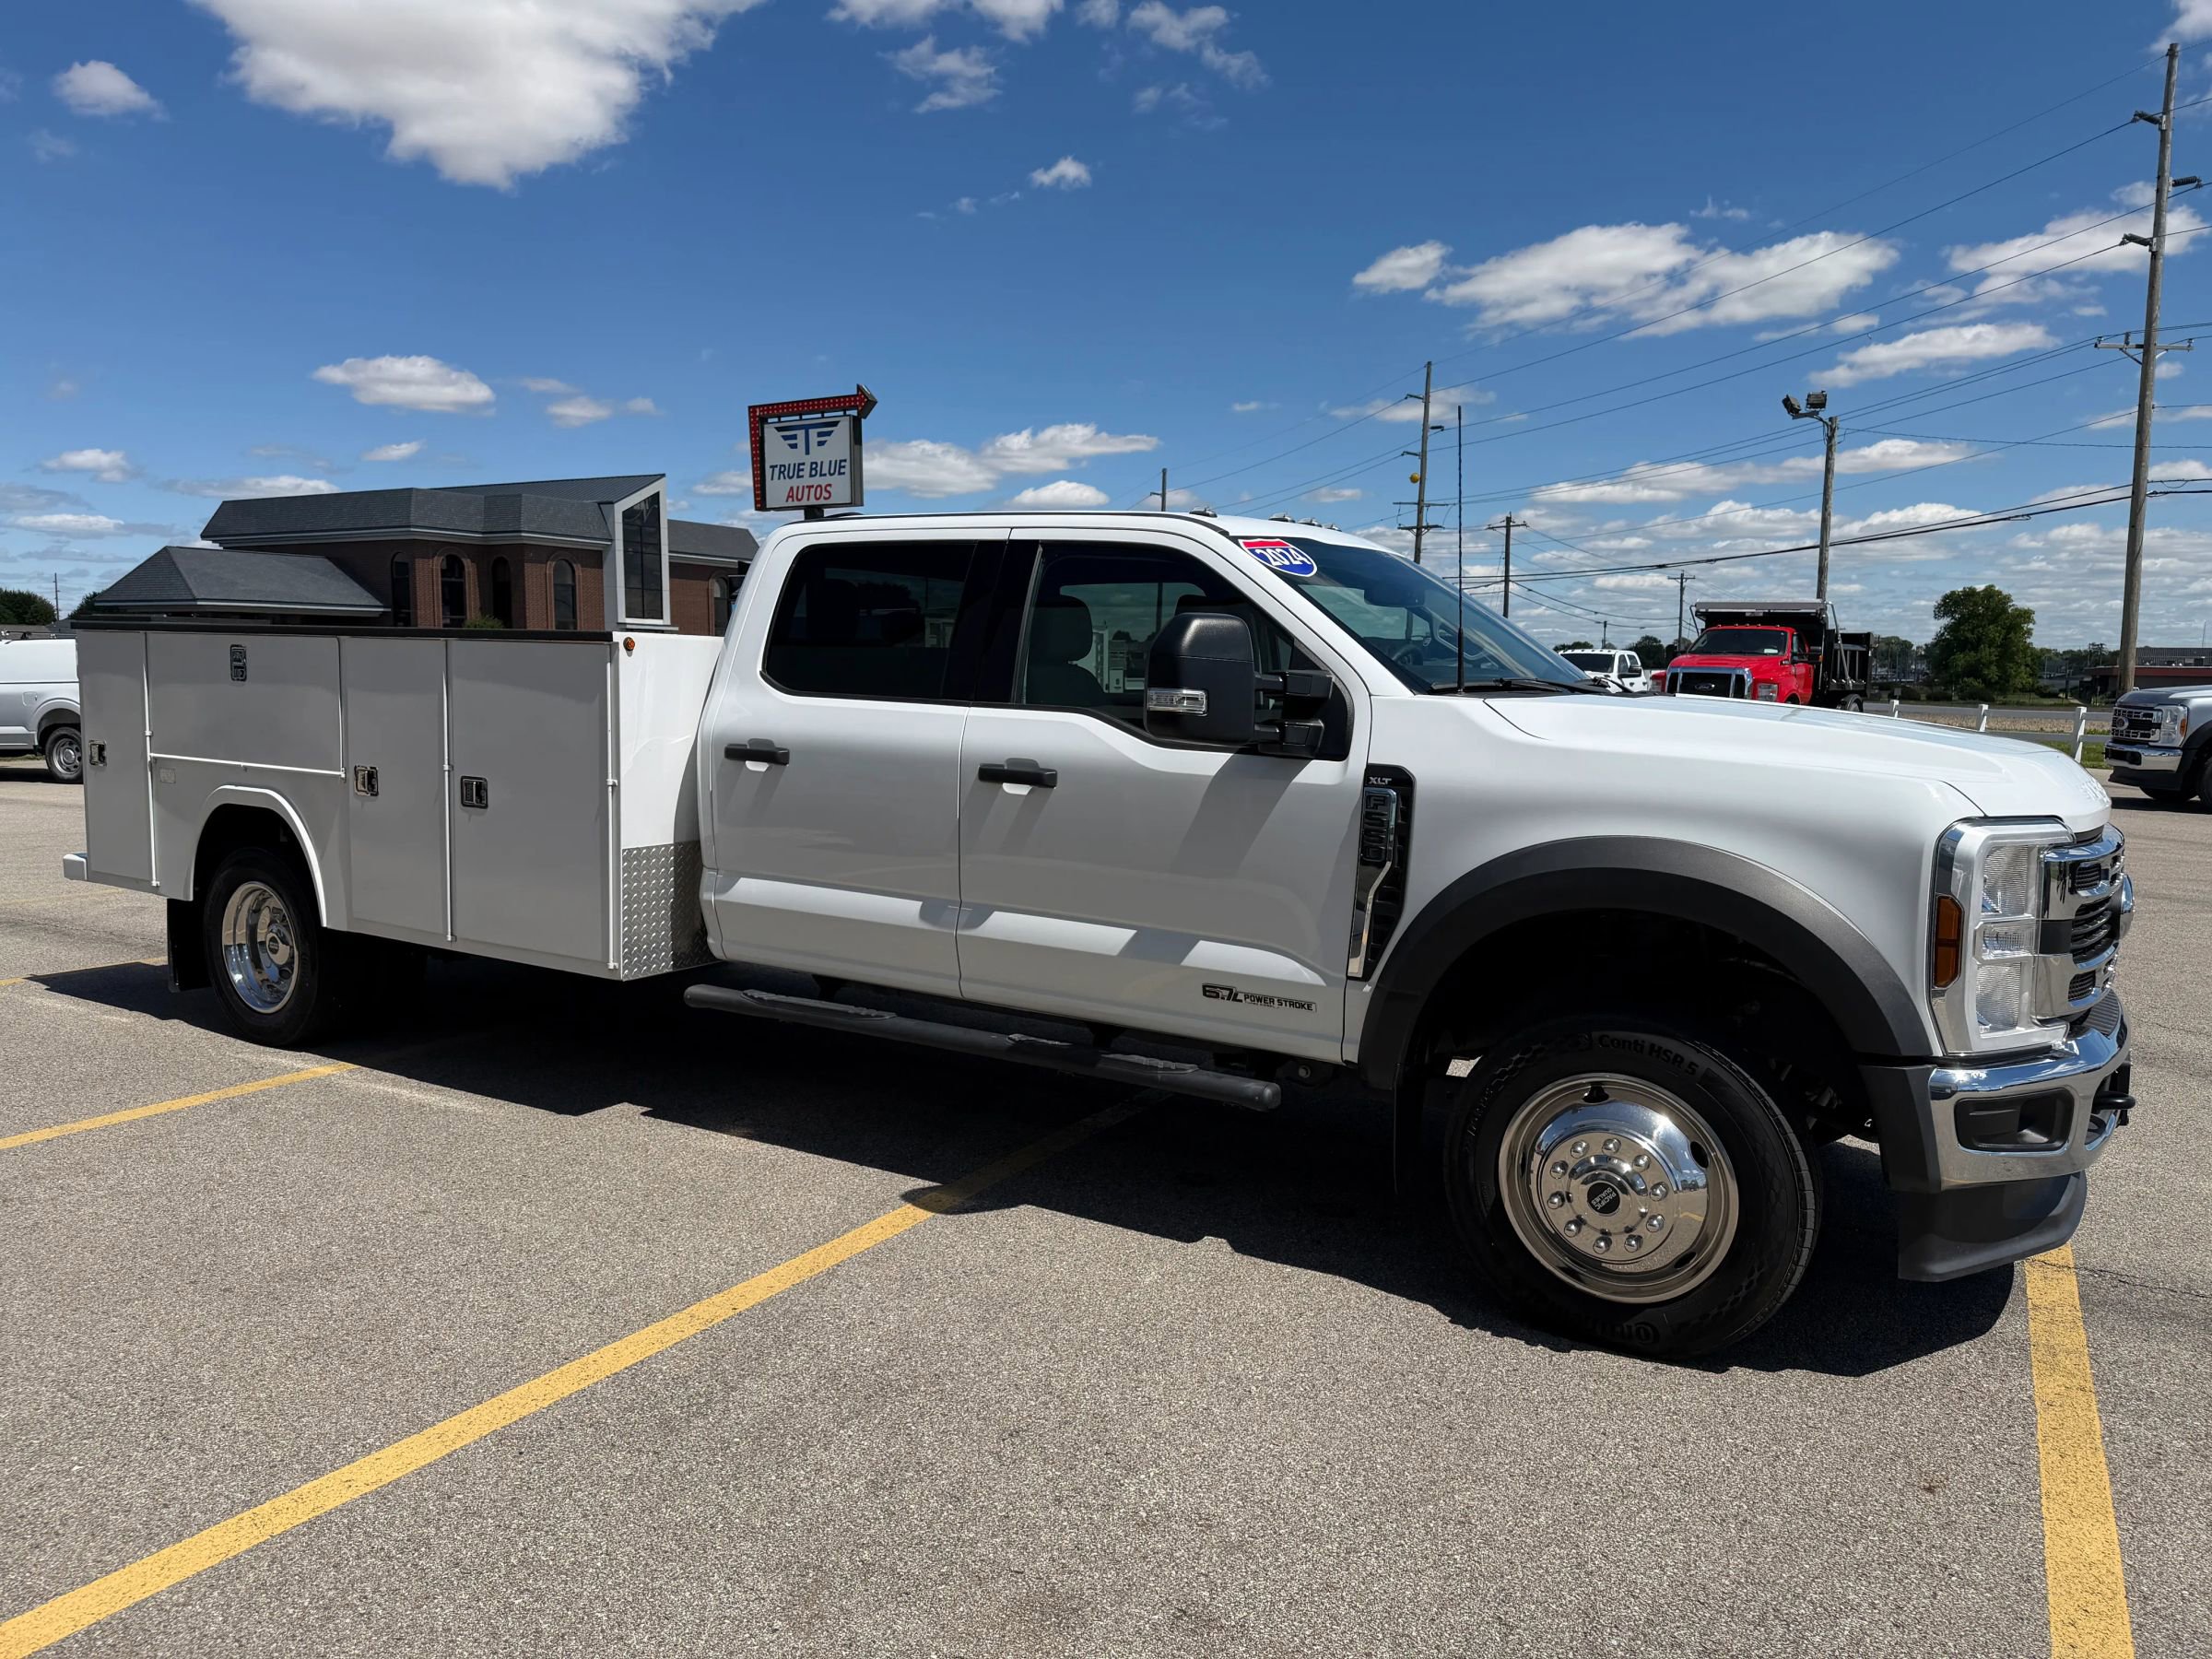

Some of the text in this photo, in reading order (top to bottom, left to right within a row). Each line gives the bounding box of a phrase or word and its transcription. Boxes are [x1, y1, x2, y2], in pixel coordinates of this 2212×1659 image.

[770, 459, 847, 481] TRUE BLUE
[785, 483, 832, 502] AUTOS
[1254, 547, 1312, 567] 2024
[1368, 776, 1392, 785] XLT
[1202, 983, 1242, 1003] 6.7L
[1244, 994, 1275, 1006] POWER
[1277, 998, 1313, 1011] STROKE
[1598, 1034, 1700, 1076] Conti HSR 5
[1591, 1187, 1613, 1206] DUALIES
[1595, 1191, 1617, 1210] PACIFIC
